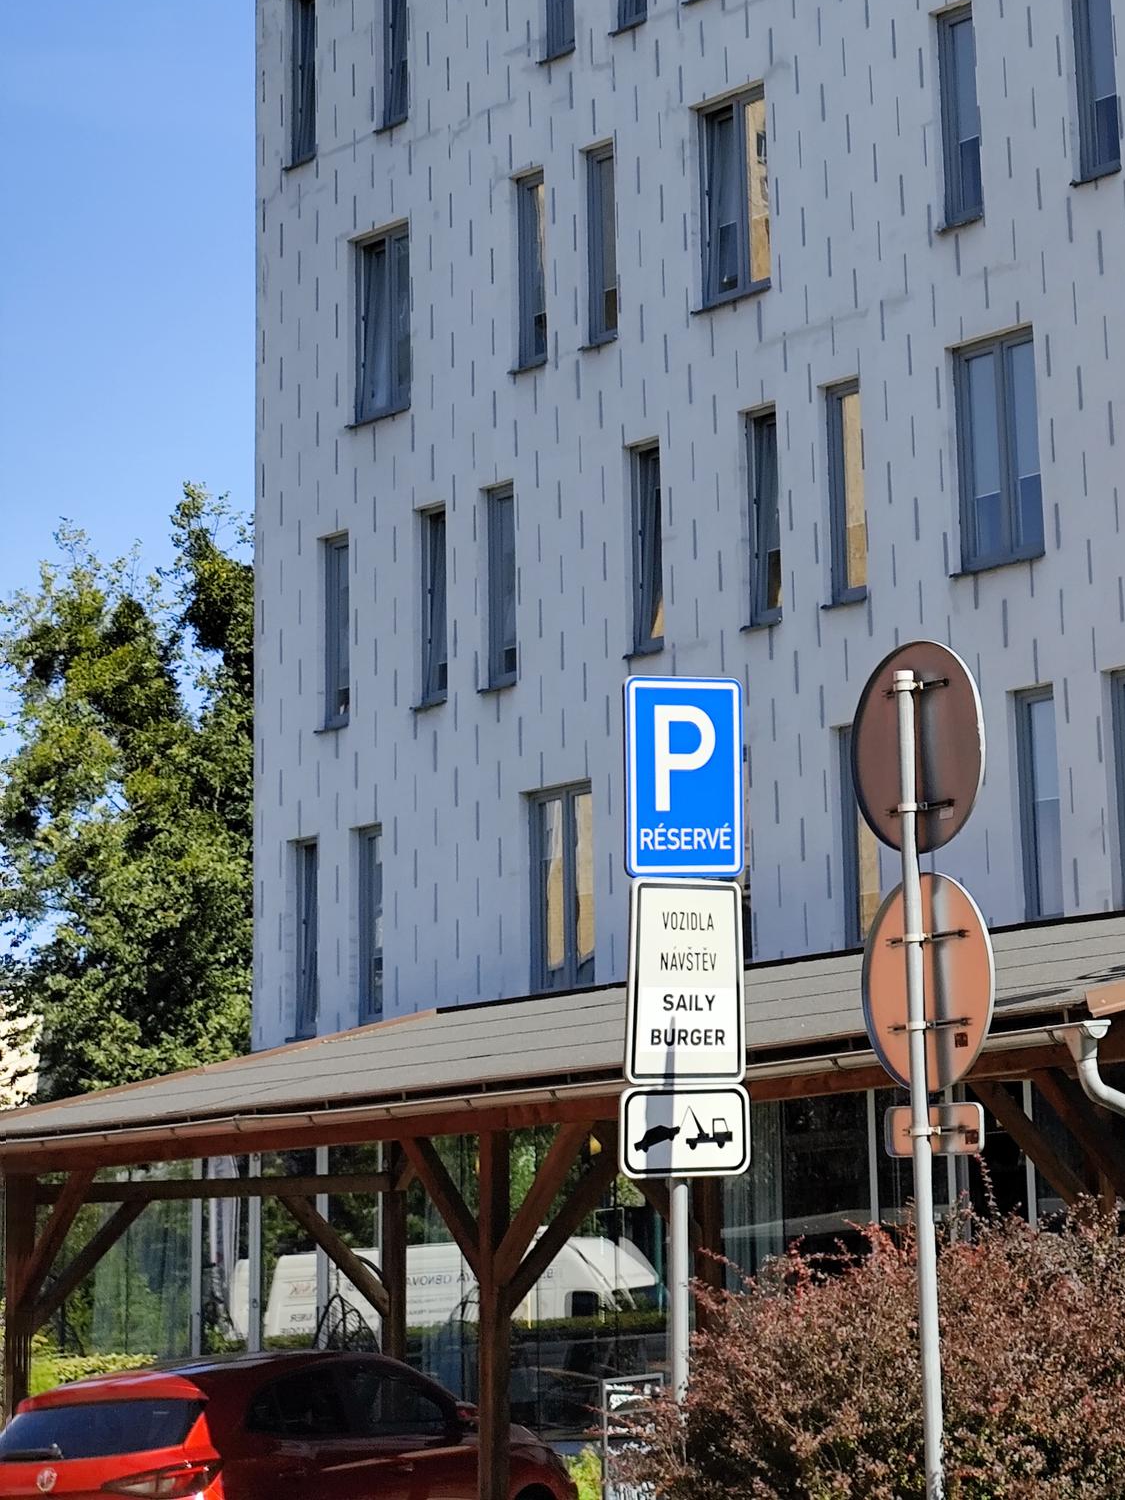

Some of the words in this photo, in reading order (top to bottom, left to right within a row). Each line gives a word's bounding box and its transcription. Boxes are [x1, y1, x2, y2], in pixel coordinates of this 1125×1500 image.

[654, 704, 717, 812] P
[639, 822, 733, 851] RÉSERVÉ
[662, 911, 715, 931] VOZIDLA
[660, 945, 717, 972] NÁVŠTĚV
[662, 993, 716, 1012] SAILY
[650, 1028, 726, 1047] BURGER
